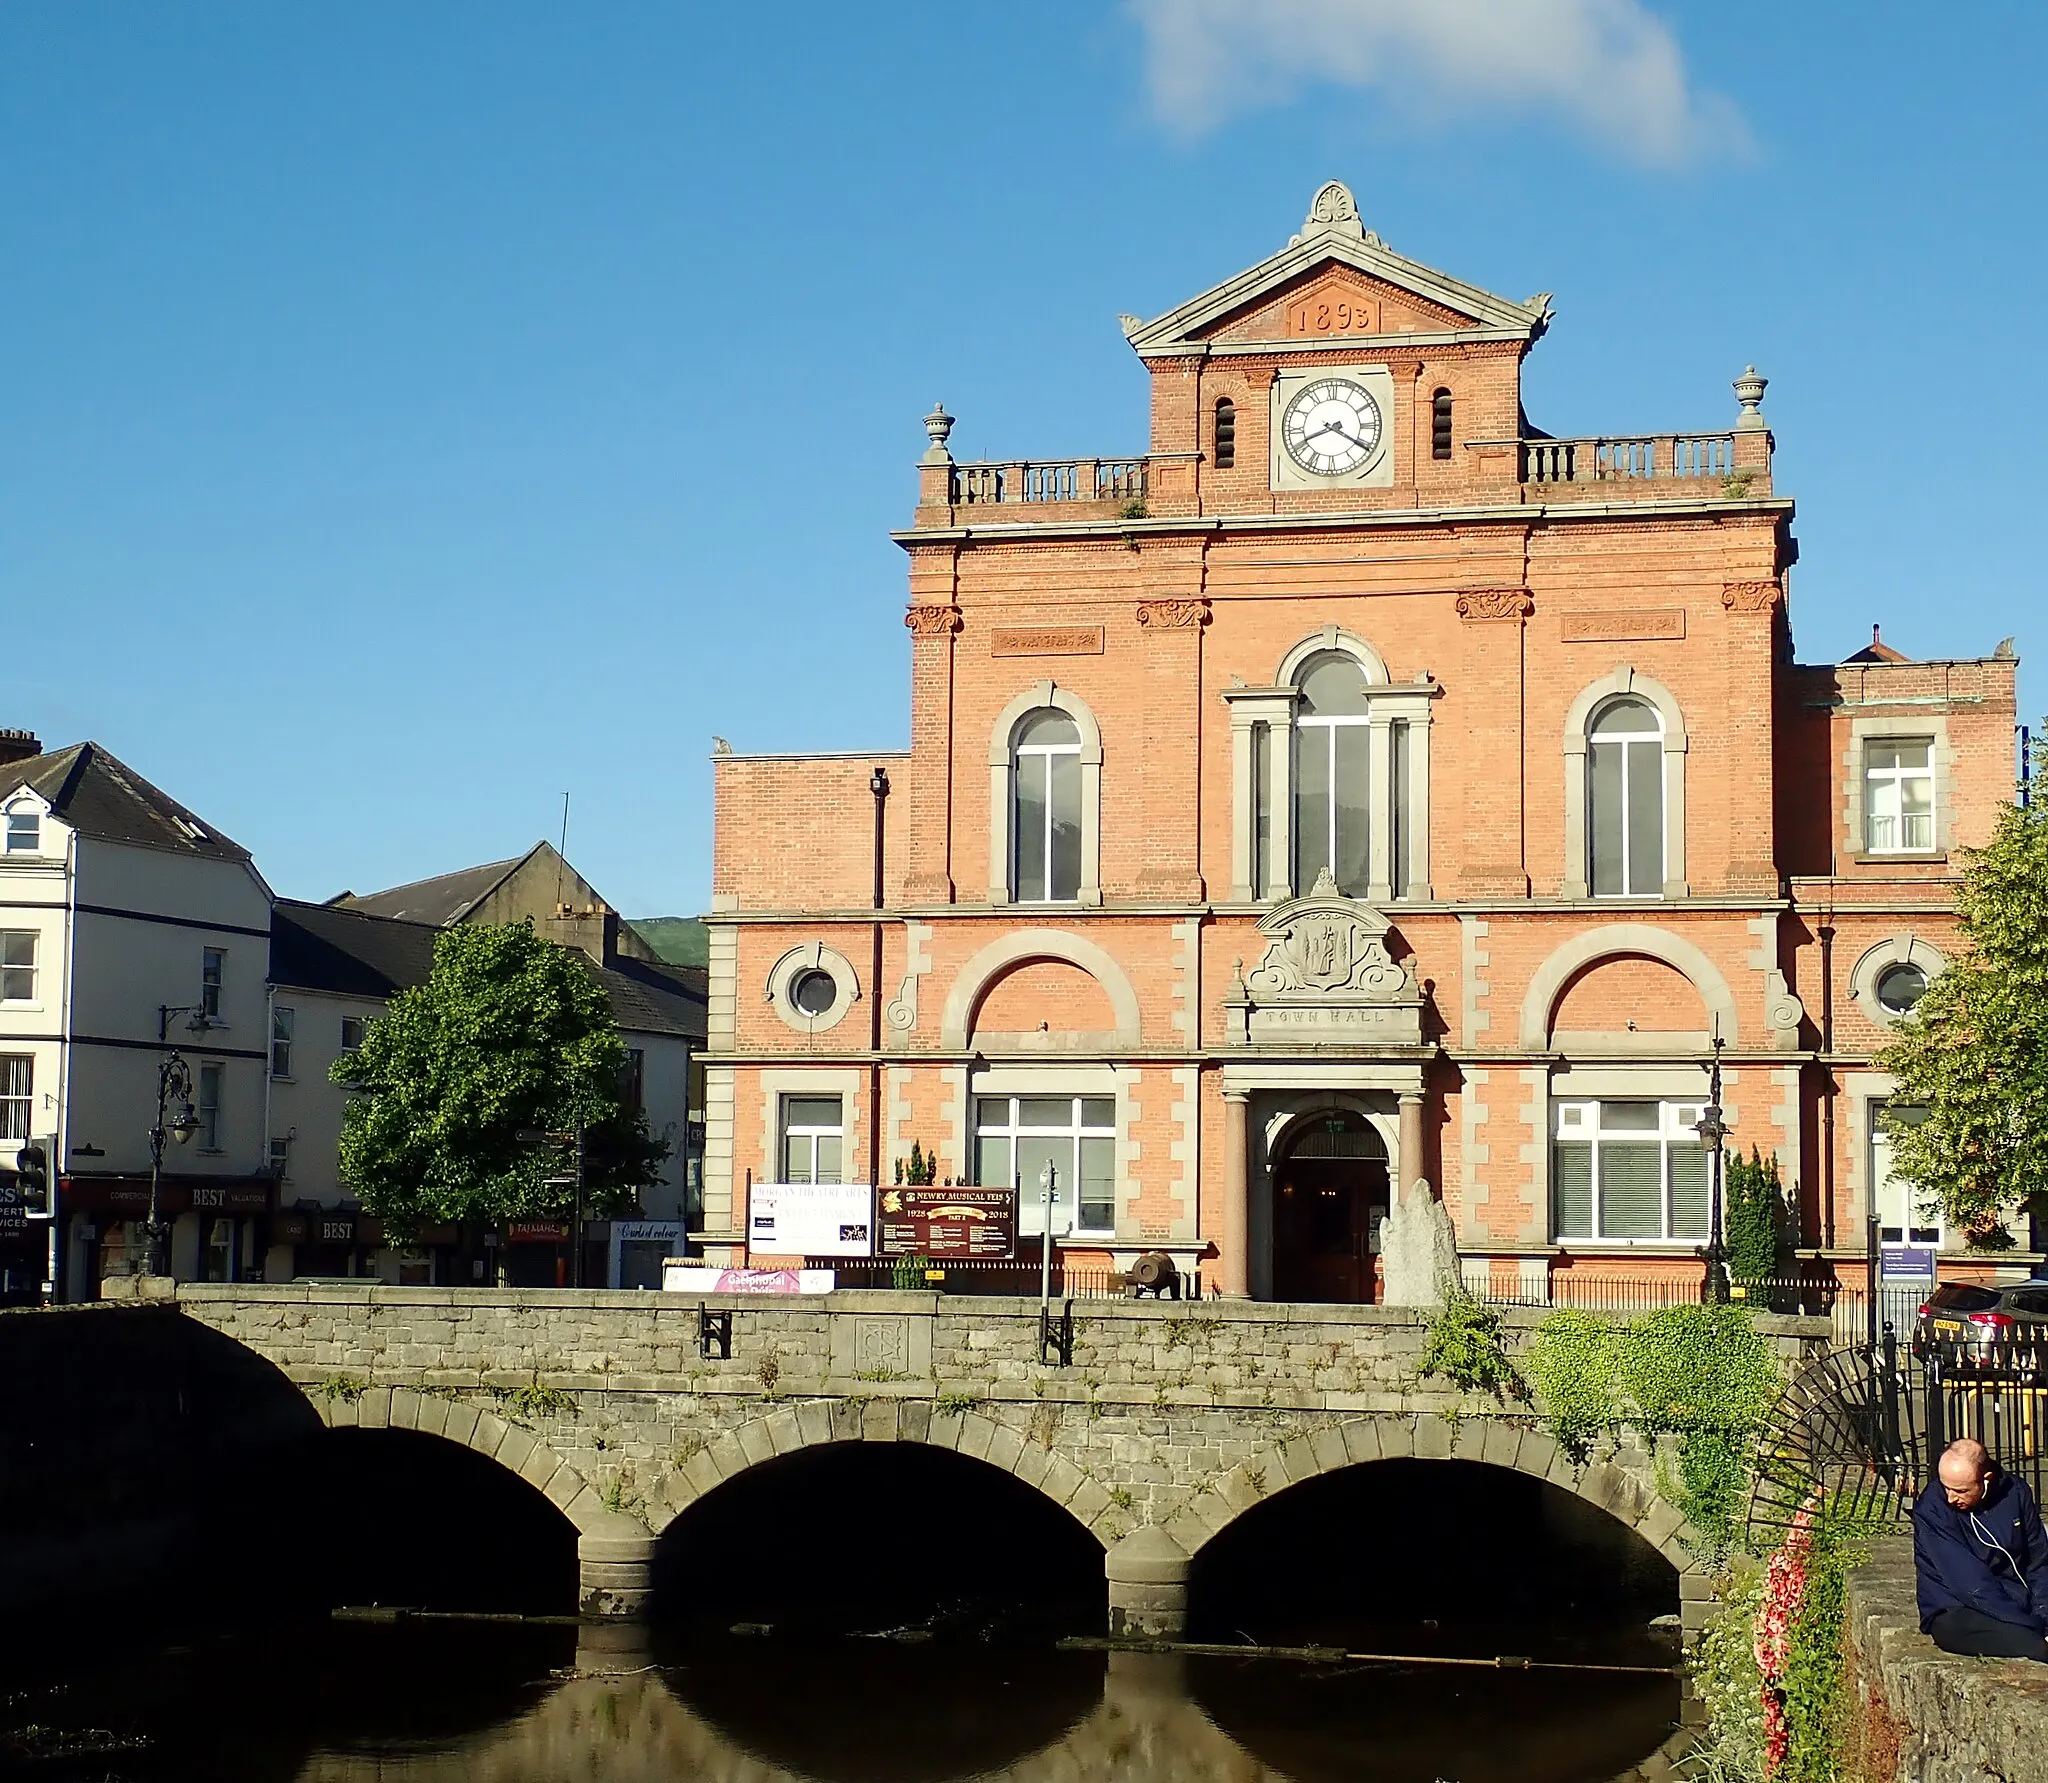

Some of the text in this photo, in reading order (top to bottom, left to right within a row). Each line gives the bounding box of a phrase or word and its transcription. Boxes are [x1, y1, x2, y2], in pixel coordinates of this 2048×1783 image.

[1299, 303, 1369, 331] 1893
[1265, 1011, 1384, 1022] TOWN HALL
[193, 1188, 225, 1206] BEST
[916, 1192, 1003, 1201] NEWRY MUSICAL FEIS
[323, 1222, 352, 1239] BEST
